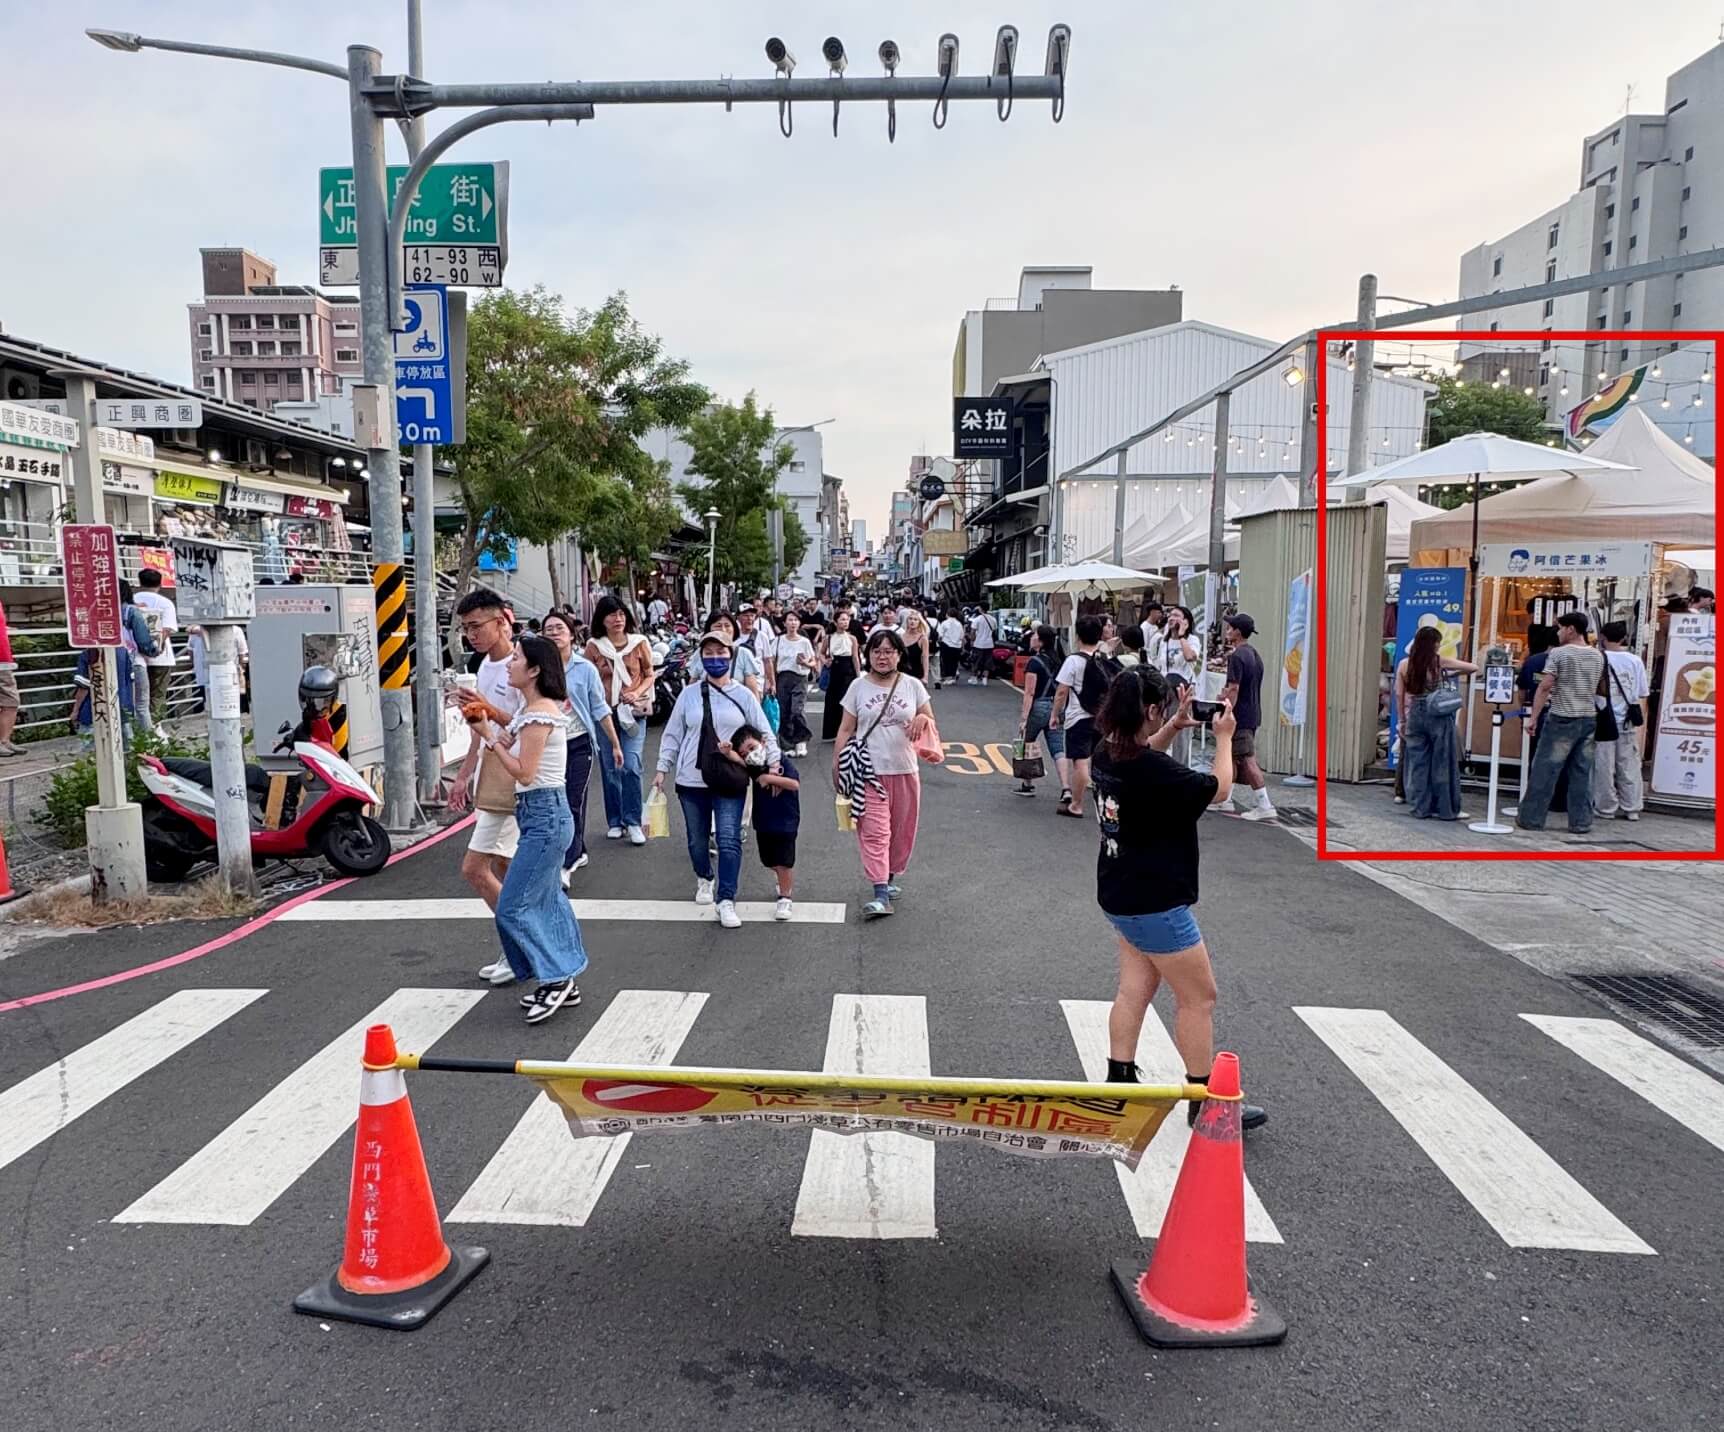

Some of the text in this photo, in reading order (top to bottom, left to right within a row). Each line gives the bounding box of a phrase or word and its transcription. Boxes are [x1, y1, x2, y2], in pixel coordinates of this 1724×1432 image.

[452, 213, 481, 233] St.
[322, 250, 339, 270] 東
[477, 248, 497, 267] 西
[322, 272, 330, 282] E
[482, 273, 494, 283] W
[107, 404, 193, 422] 正興商圈
[961, 409, 1007, 430] 朵拉
[1534, 554, 1607, 566] 阿信芒果冰
[865, 693, 908, 710] AMERCAN
